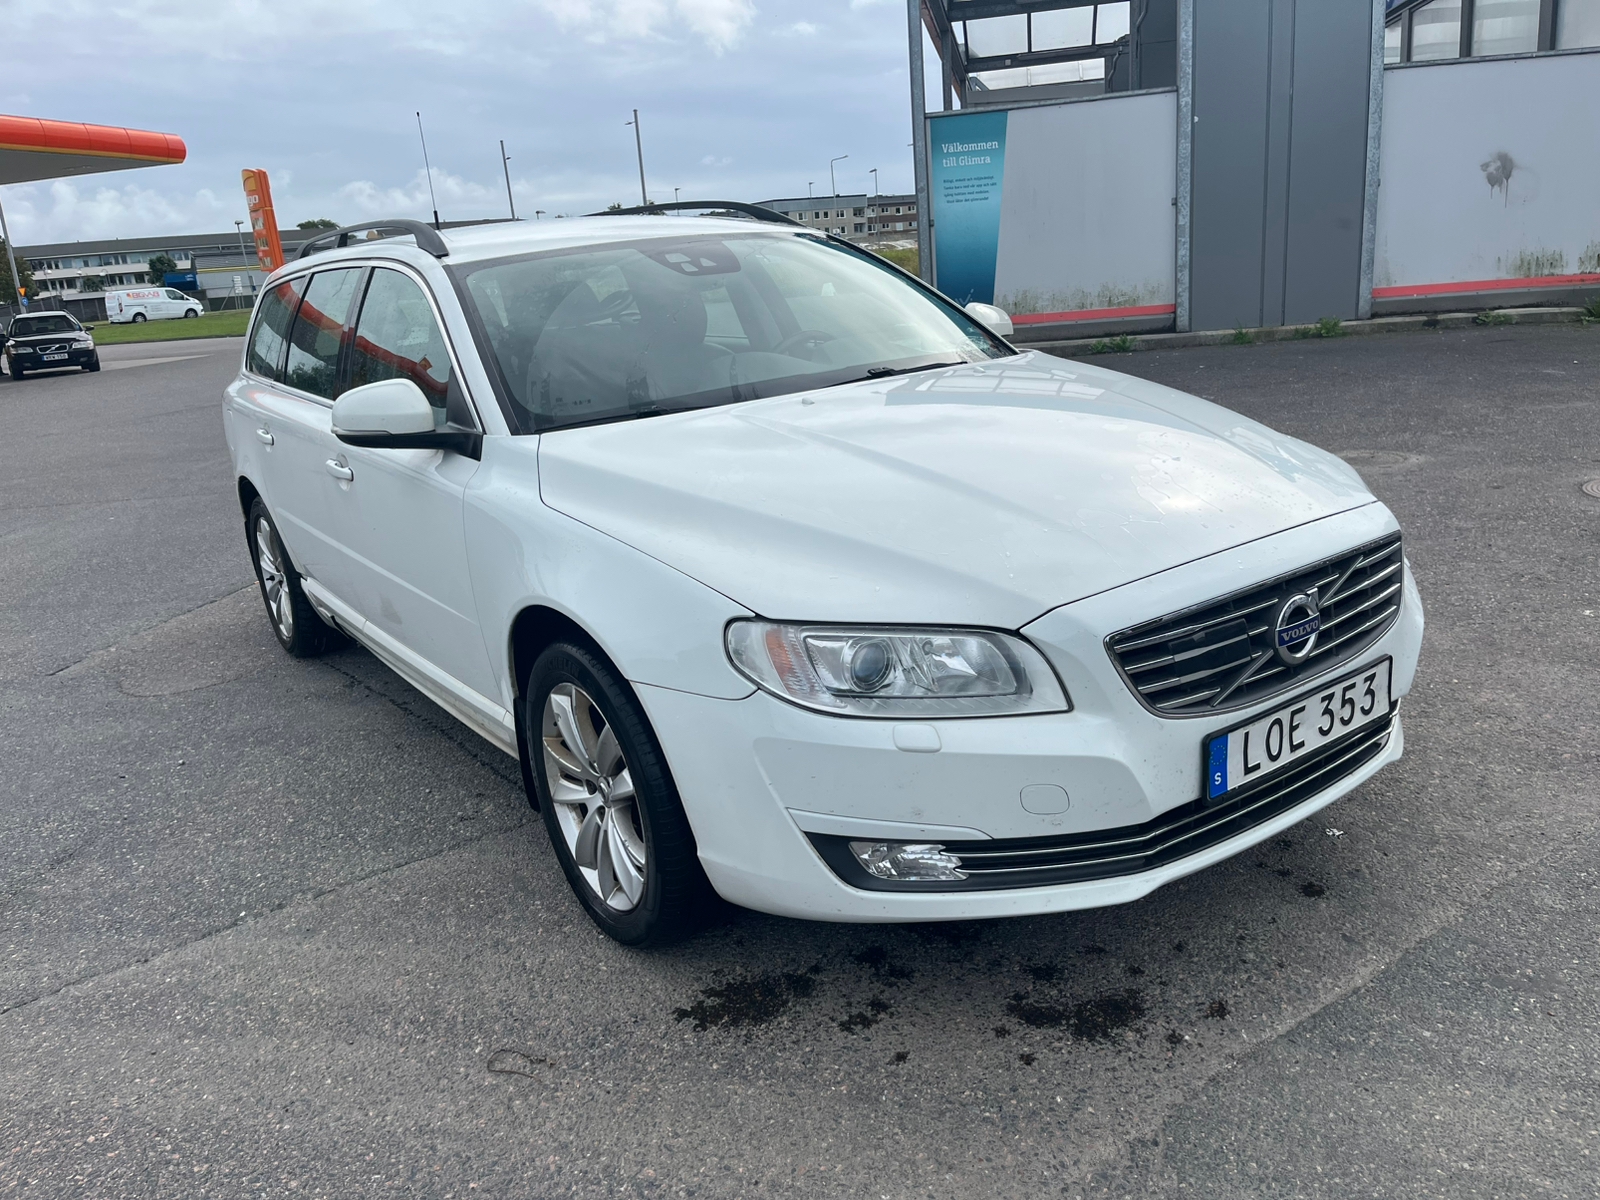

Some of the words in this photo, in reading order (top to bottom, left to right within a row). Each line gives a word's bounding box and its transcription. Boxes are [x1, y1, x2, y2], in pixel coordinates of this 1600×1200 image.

[941, 141, 999, 153] Välkommen
[942, 156, 957, 167] till
[958, 155, 991, 166] Glimra
[1281, 620, 1319, 641] VOLVO
[1243, 704, 1306, 776] LOE
[1317, 672, 1377, 737] 353
[1214, 772, 1222, 785] S
